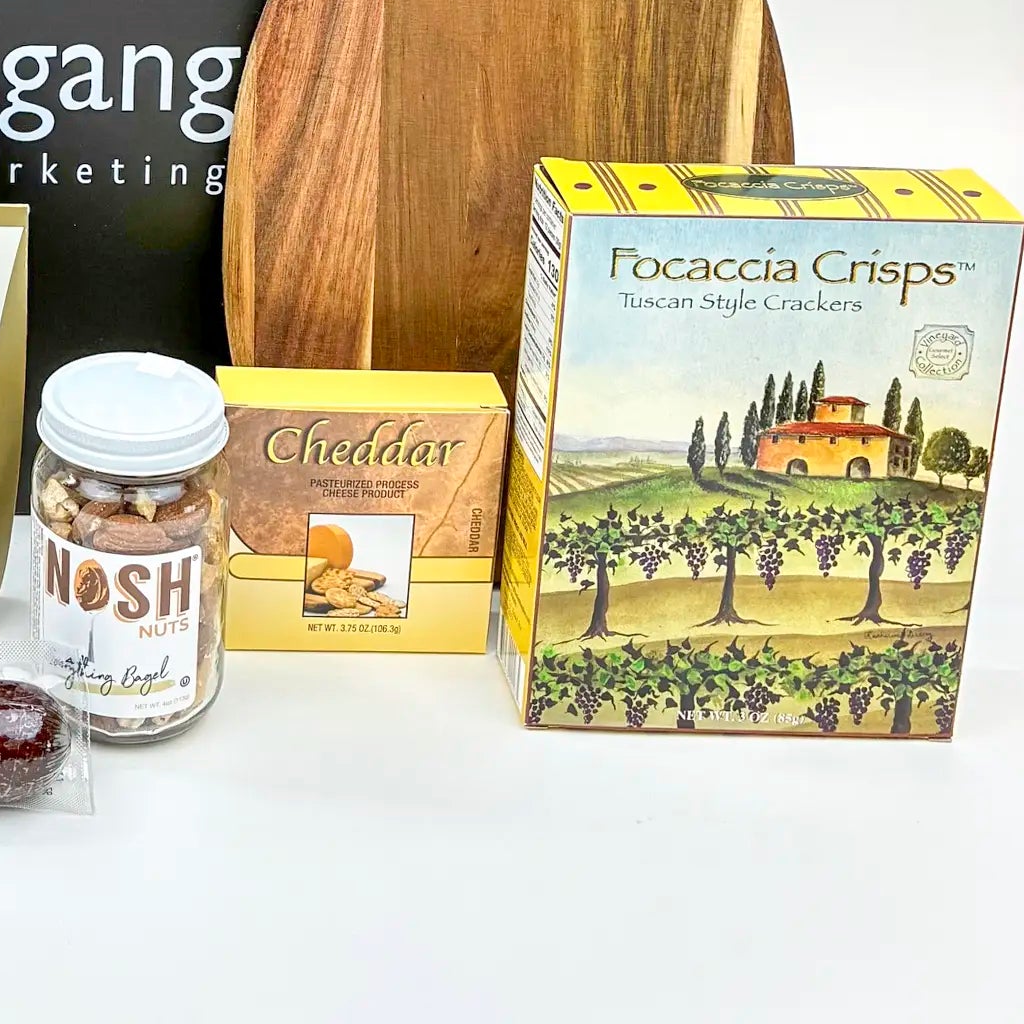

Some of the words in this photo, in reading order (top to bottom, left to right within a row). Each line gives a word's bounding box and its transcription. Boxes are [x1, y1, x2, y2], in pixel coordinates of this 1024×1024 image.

[609, 246, 799, 286] Focaccia
[618, 291, 695, 310] Tuscan
[699, 288, 758, 319] Style
[764, 291, 863, 313] Crackers
[264, 419, 466, 468] Cheddar
[310, 478, 373, 489] PASTEURIZED
[375, 480, 420, 490] PROCESS
[322, 489, 359, 498] CHEESE
[361, 489, 406, 499] PRODUCT
[467, 507, 484, 554] CHEDDAR
[138, 617, 190, 640] NUTS
[307, 623, 323, 632] NET
[324, 624, 338, 632] WT.
[340, 624, 357, 632] 3.75
[121, 655, 170, 697] Bagel
[676, 709, 707, 721] NET
[708, 710, 735, 722] WT.
[739, 712, 746, 723] 3
[749, 711, 769, 724] OZ
